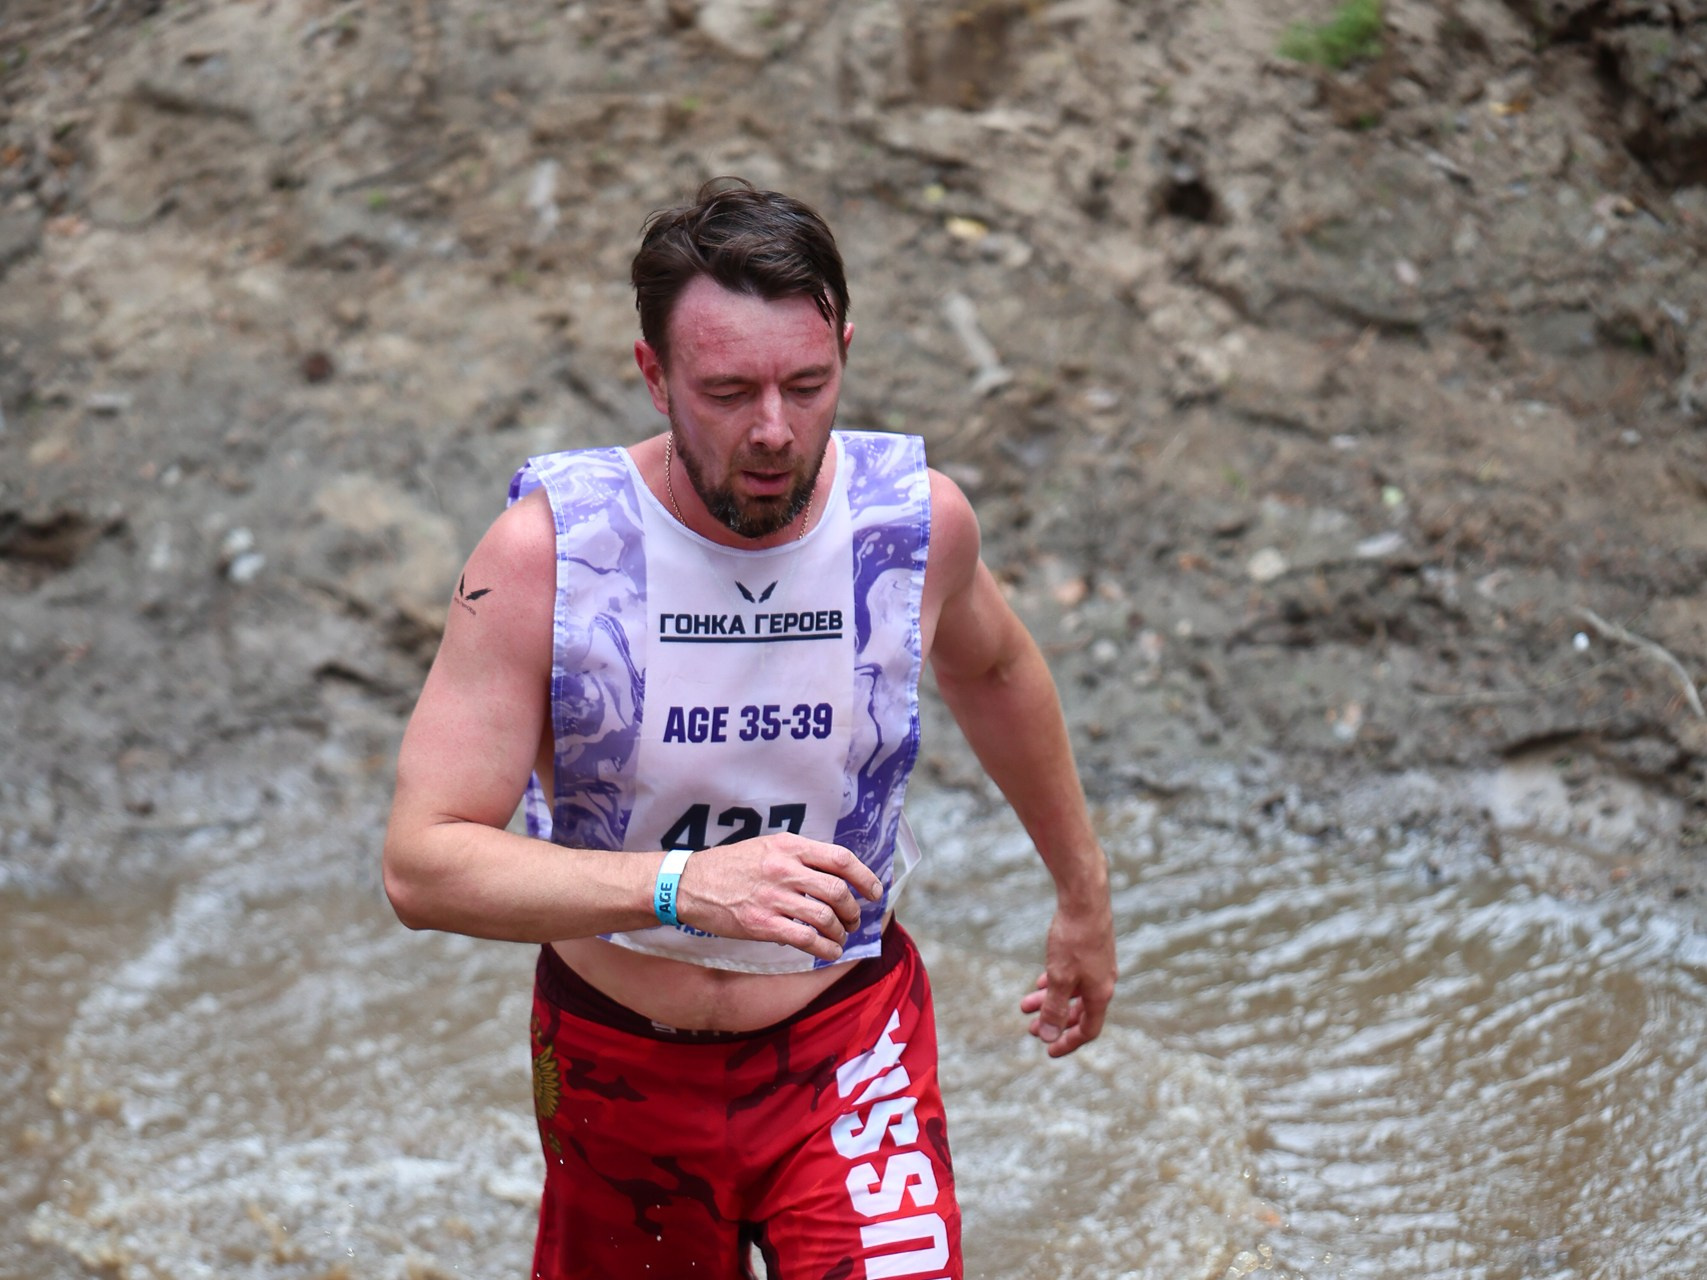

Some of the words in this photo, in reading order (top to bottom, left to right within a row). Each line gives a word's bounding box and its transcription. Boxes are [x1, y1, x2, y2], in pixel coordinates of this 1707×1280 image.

[660, 613, 745, 635] ГОНКА
[754, 610, 843, 634] ГЕРОЕВ
[663, 706, 729, 743] AGE
[739, 702, 833, 742] 35-39
[658, 882, 673, 914] AGE
